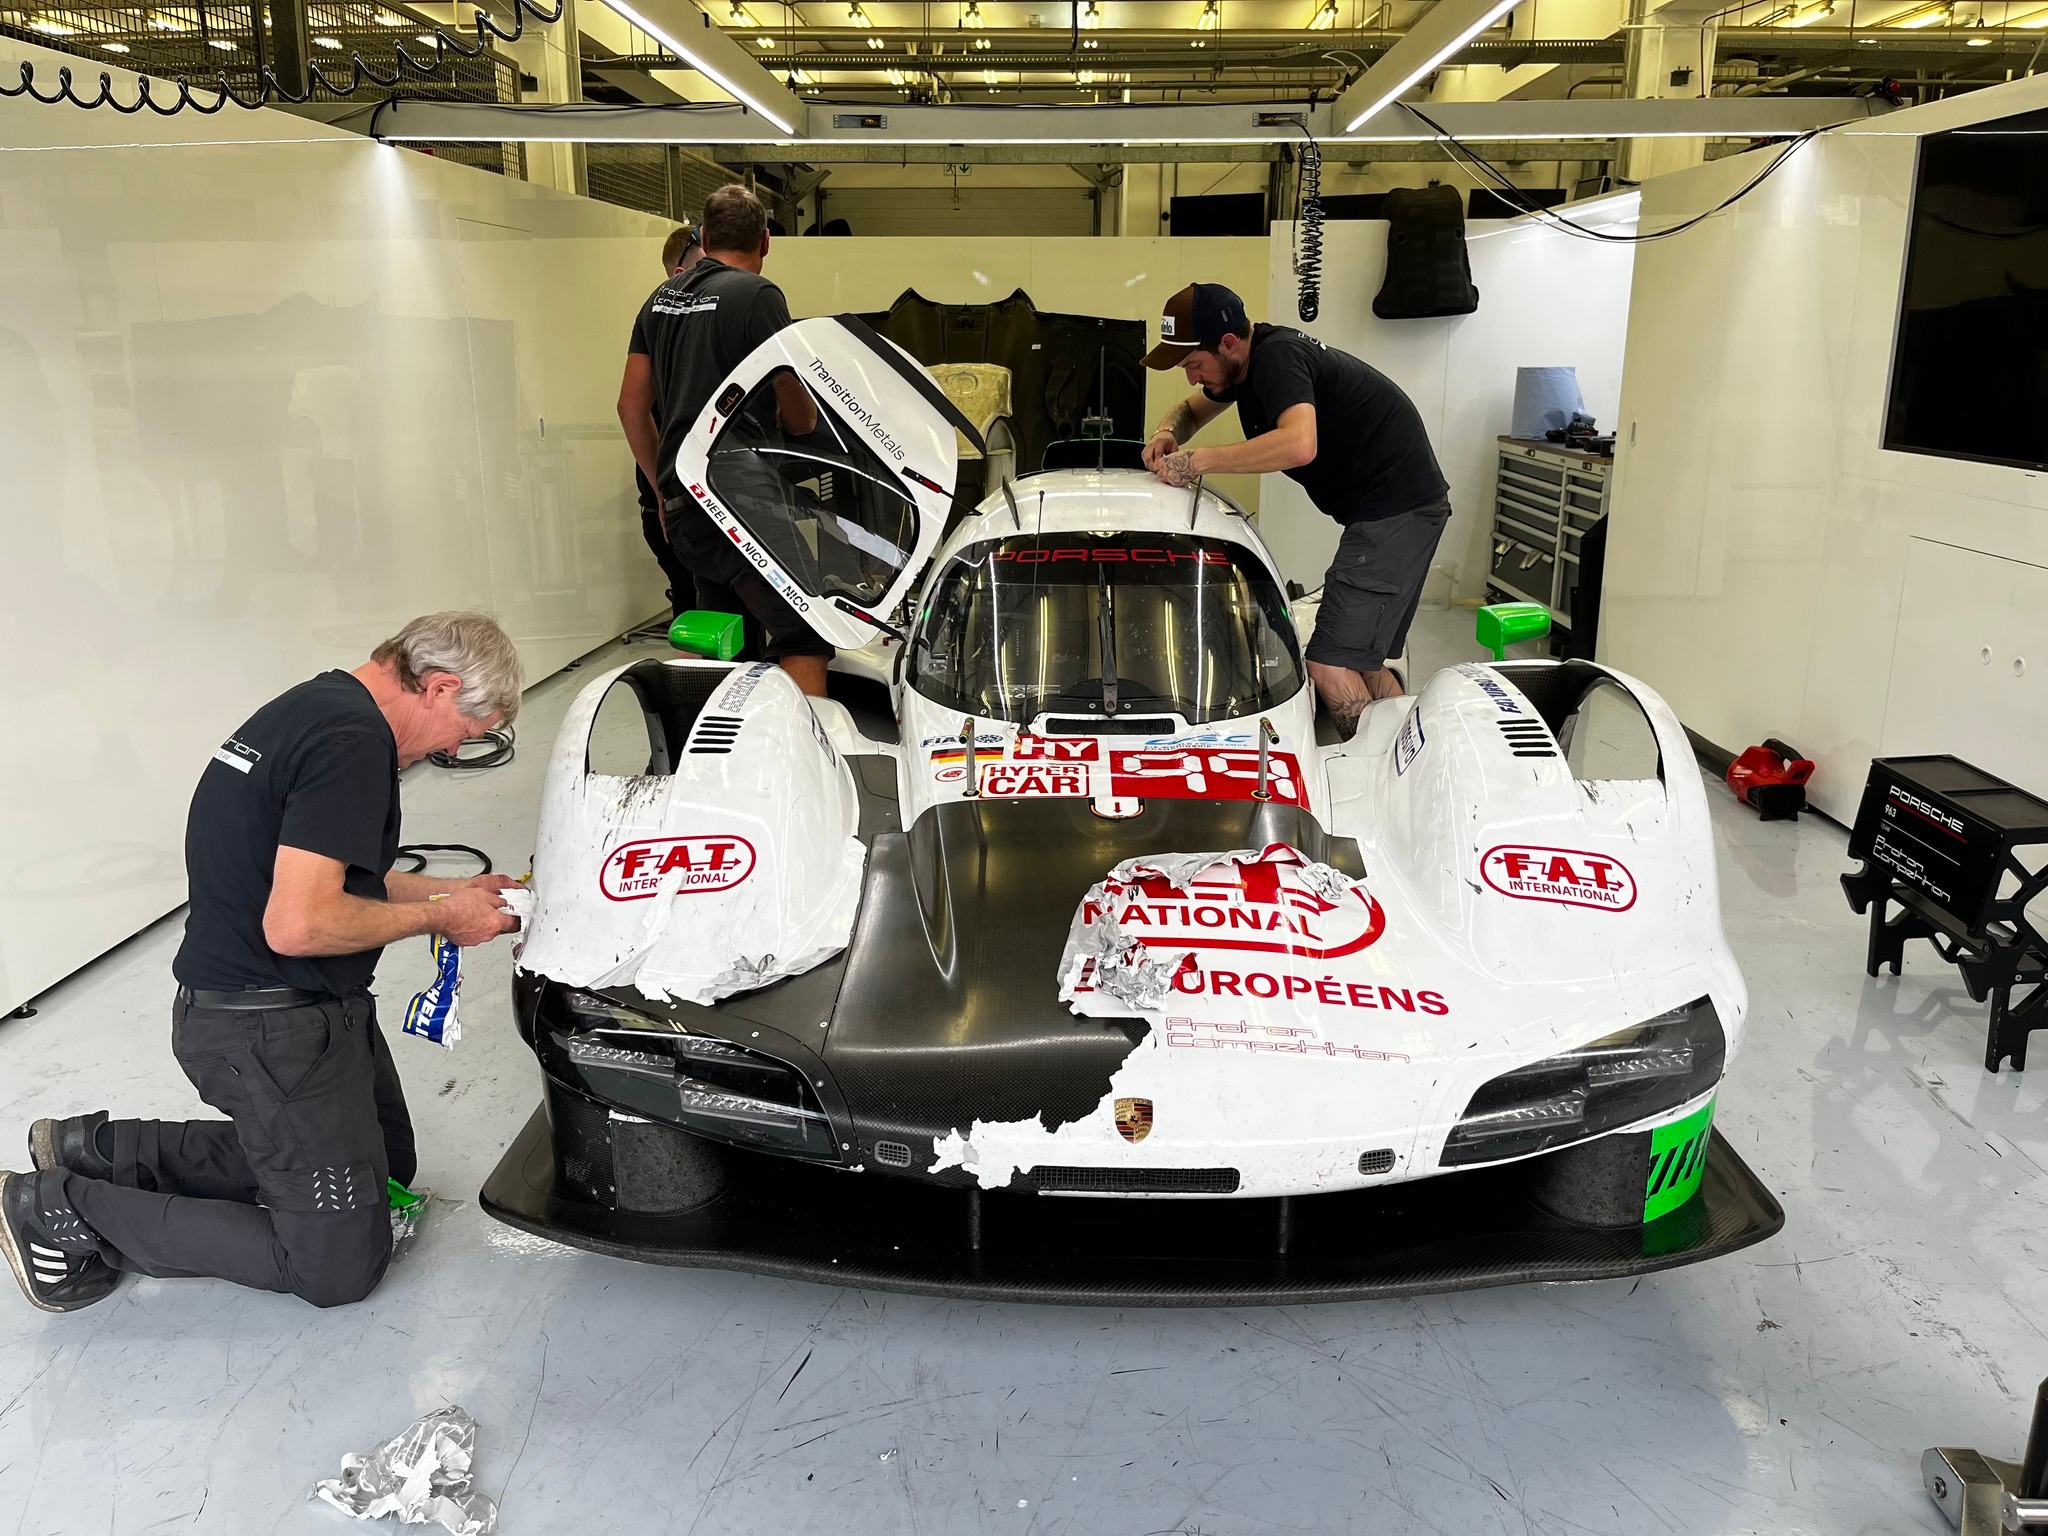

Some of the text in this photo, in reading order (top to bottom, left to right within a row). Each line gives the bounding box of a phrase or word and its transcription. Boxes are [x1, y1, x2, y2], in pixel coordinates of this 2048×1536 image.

[809, 357, 905, 461] TransitionMetals
[703, 498, 809, 613] NEEL NICO NICO
[987, 548, 1230, 566] PORSCHE
[922, 736, 957, 747] FIA
[1020, 737, 1095, 758] HY
[989, 766, 1080, 776] HYPER
[1122, 752, 1298, 800] 99
[988, 776, 1080, 795] CAR
[1884, 804, 1897, 818] 963
[1889, 785, 1964, 834] PORSCHE
[1875, 834, 1924, 873] Proton
[618, 872, 729, 893] INTERIONAL
[1509, 880, 1620, 904] INTERNATIONAL
[1173, 967, 1450, 1016] UROPÉENS
[1166, 1016, 1317, 1039] Proton
